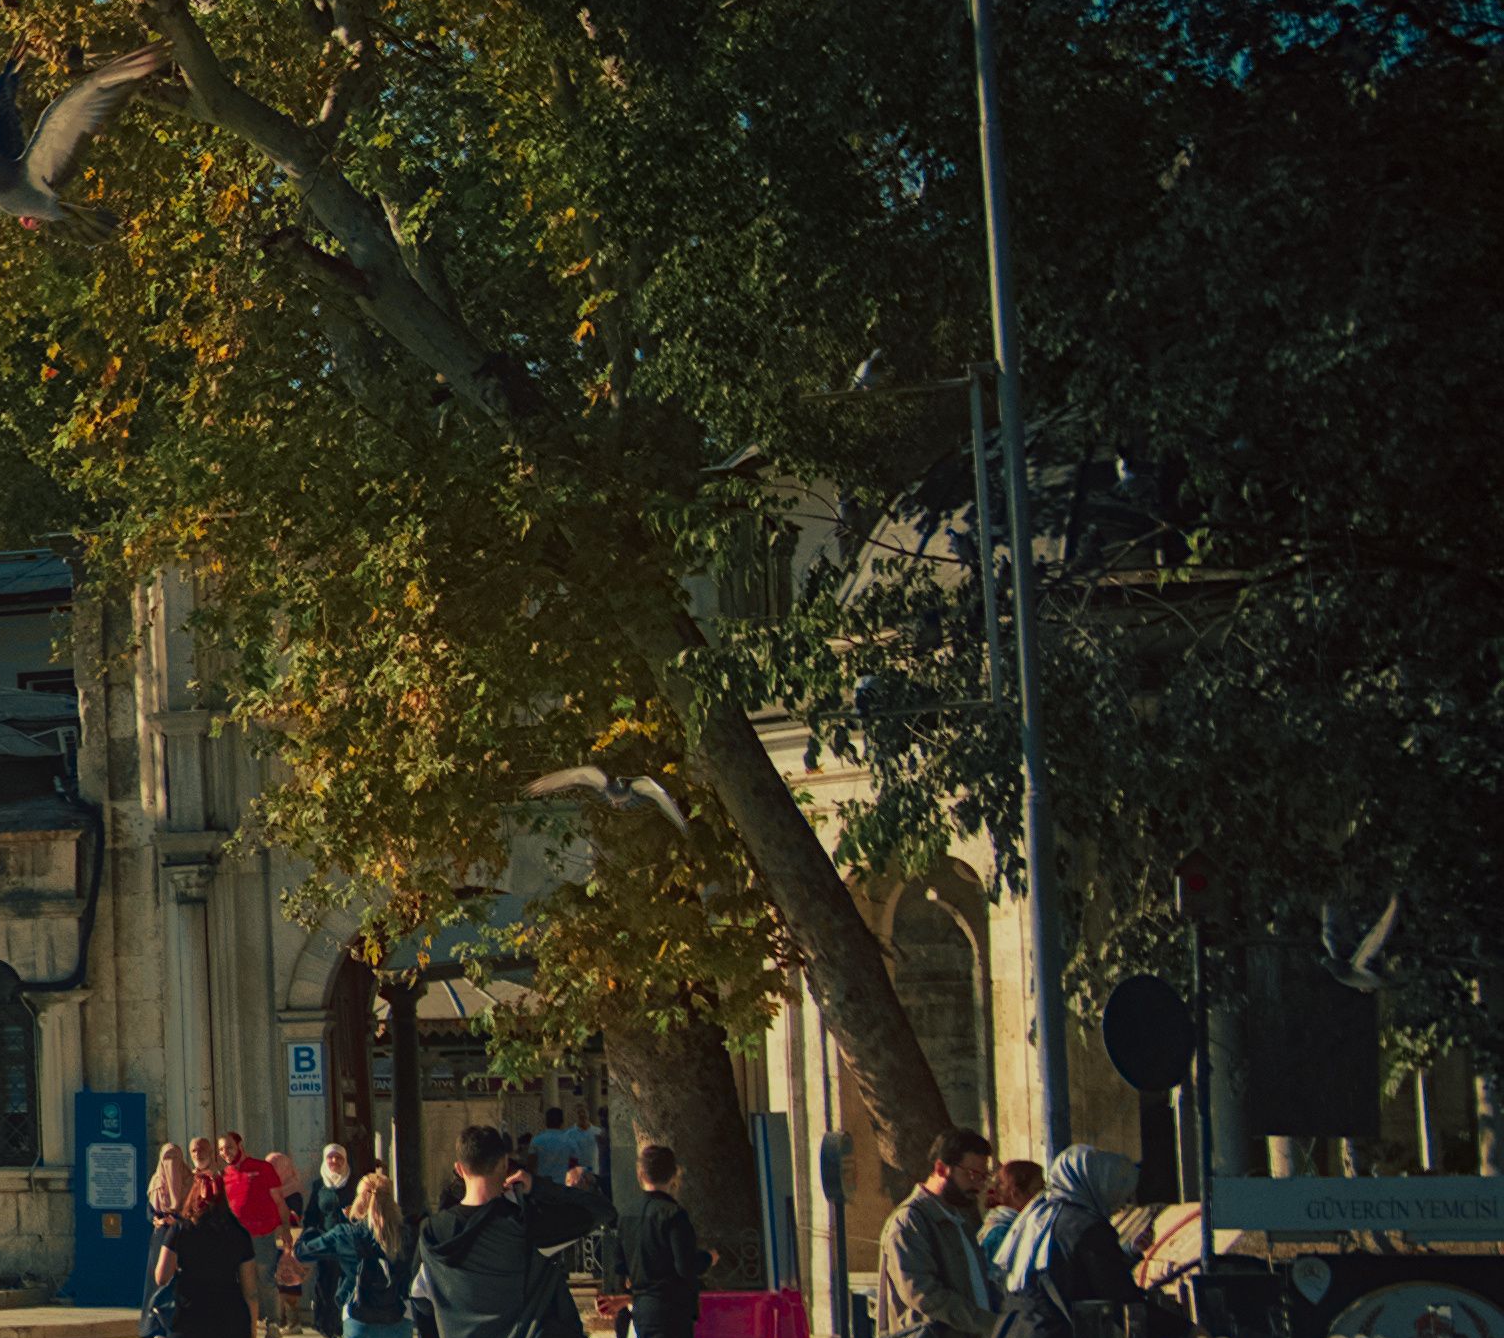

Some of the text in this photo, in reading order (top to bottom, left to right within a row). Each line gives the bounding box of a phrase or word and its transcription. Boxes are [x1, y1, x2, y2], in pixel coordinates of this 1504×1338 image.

[294, 1046, 316, 1072] B
[290, 1080, 322, 1092] GİRİŞ
[1306, 1193, 1499, 1221] GÜVERCİN YEMCİSİ
